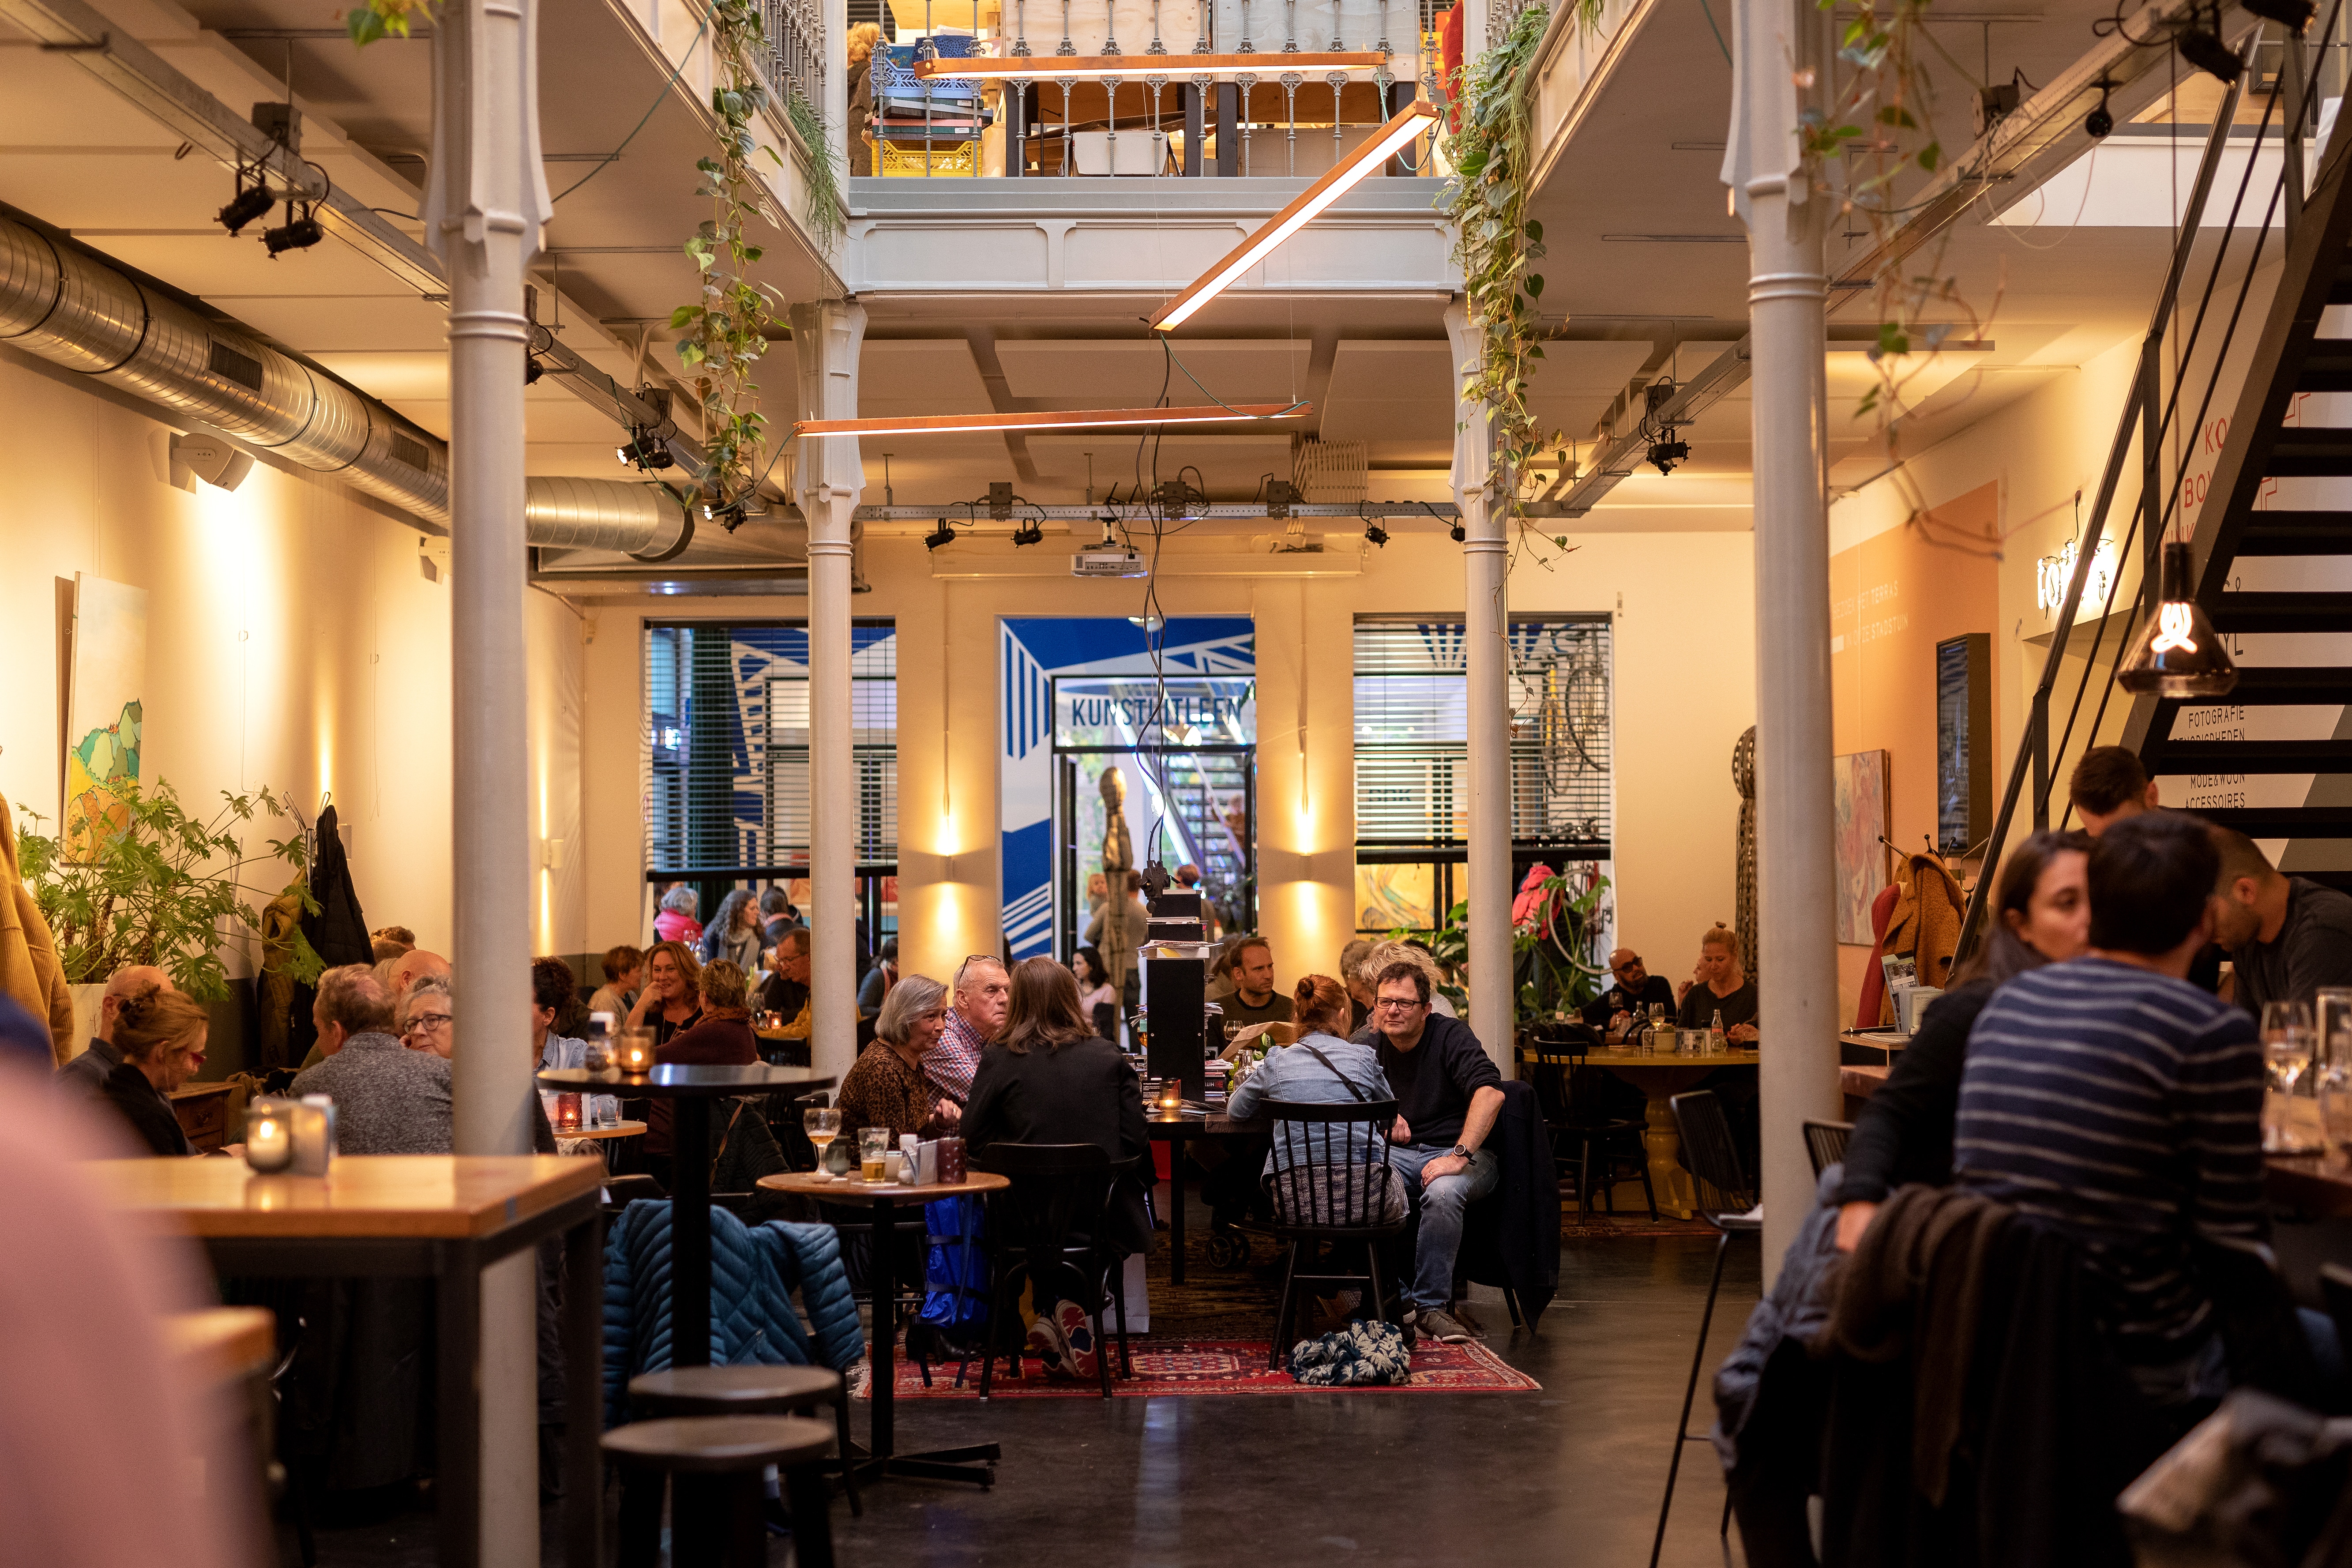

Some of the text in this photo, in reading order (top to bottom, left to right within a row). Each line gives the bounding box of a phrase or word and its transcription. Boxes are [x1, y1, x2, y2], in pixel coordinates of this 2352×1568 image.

[2205, 415, 2232, 455] KO
[2184, 470, 2212, 508] BO
[1871, 579, 1898, 605] TERRAS
[1871, 611, 1909, 640] STADSTUIN
[1071, 697, 1241, 726] KUNSTUITLEEN
[2188, 706, 2244, 729] FOTOGRAFIE
[2185, 792, 2245, 808] ACCESSOIRES
